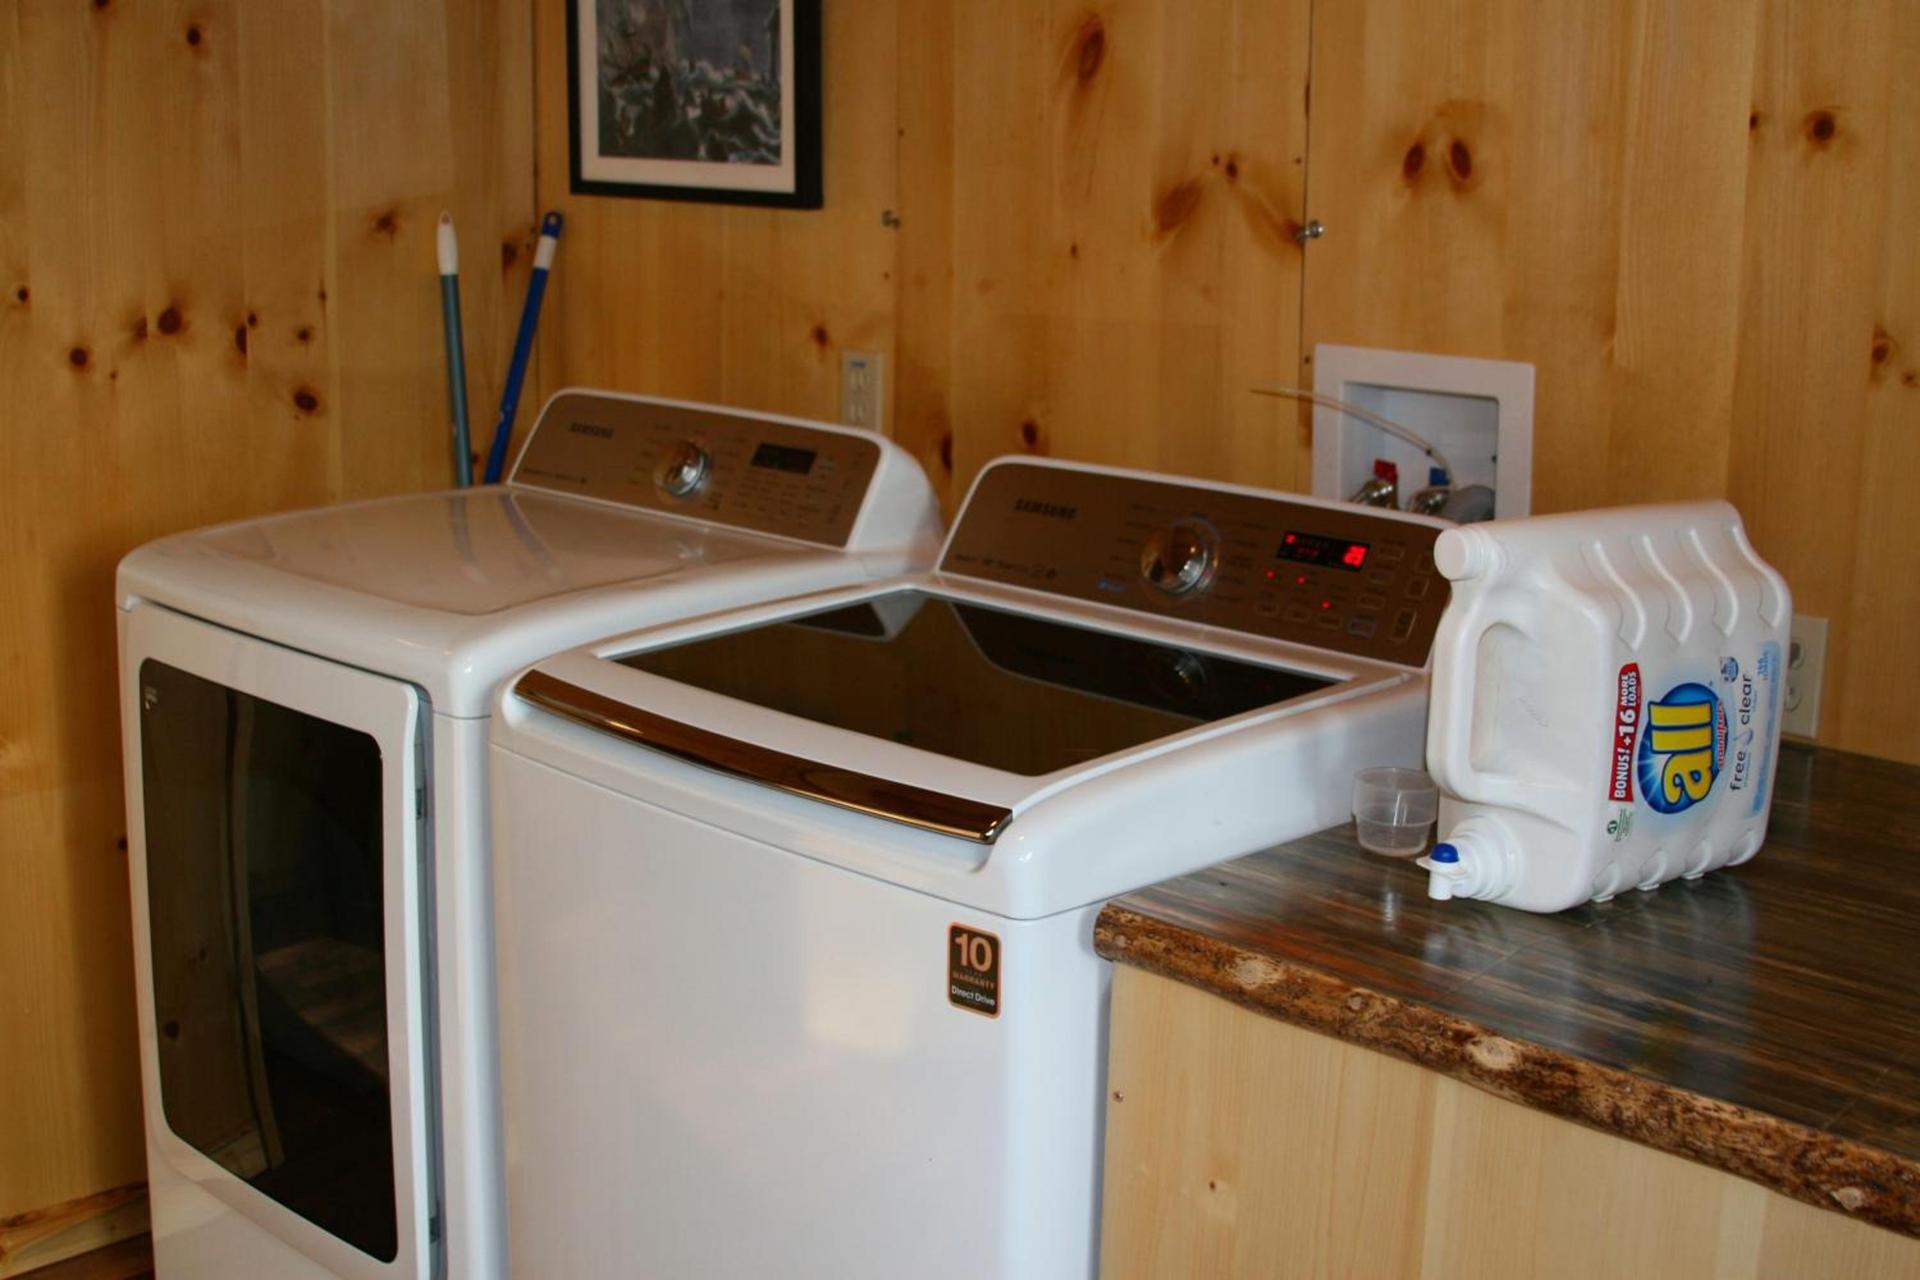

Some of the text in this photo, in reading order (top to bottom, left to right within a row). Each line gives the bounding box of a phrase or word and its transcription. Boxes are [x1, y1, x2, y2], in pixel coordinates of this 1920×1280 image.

[1015, 498, 1076, 520] SAMSUNG
[1621, 674, 1629, 706] MORE
[1628, 671, 1637, 706] LOADS
[1731, 673, 1752, 791] free clear
[1648, 701, 1713, 805] all
[1614, 748, 1631, 799] BONUS!
[955, 933, 993, 972] 10
[951, 985, 996, 1006] Direct Drive
